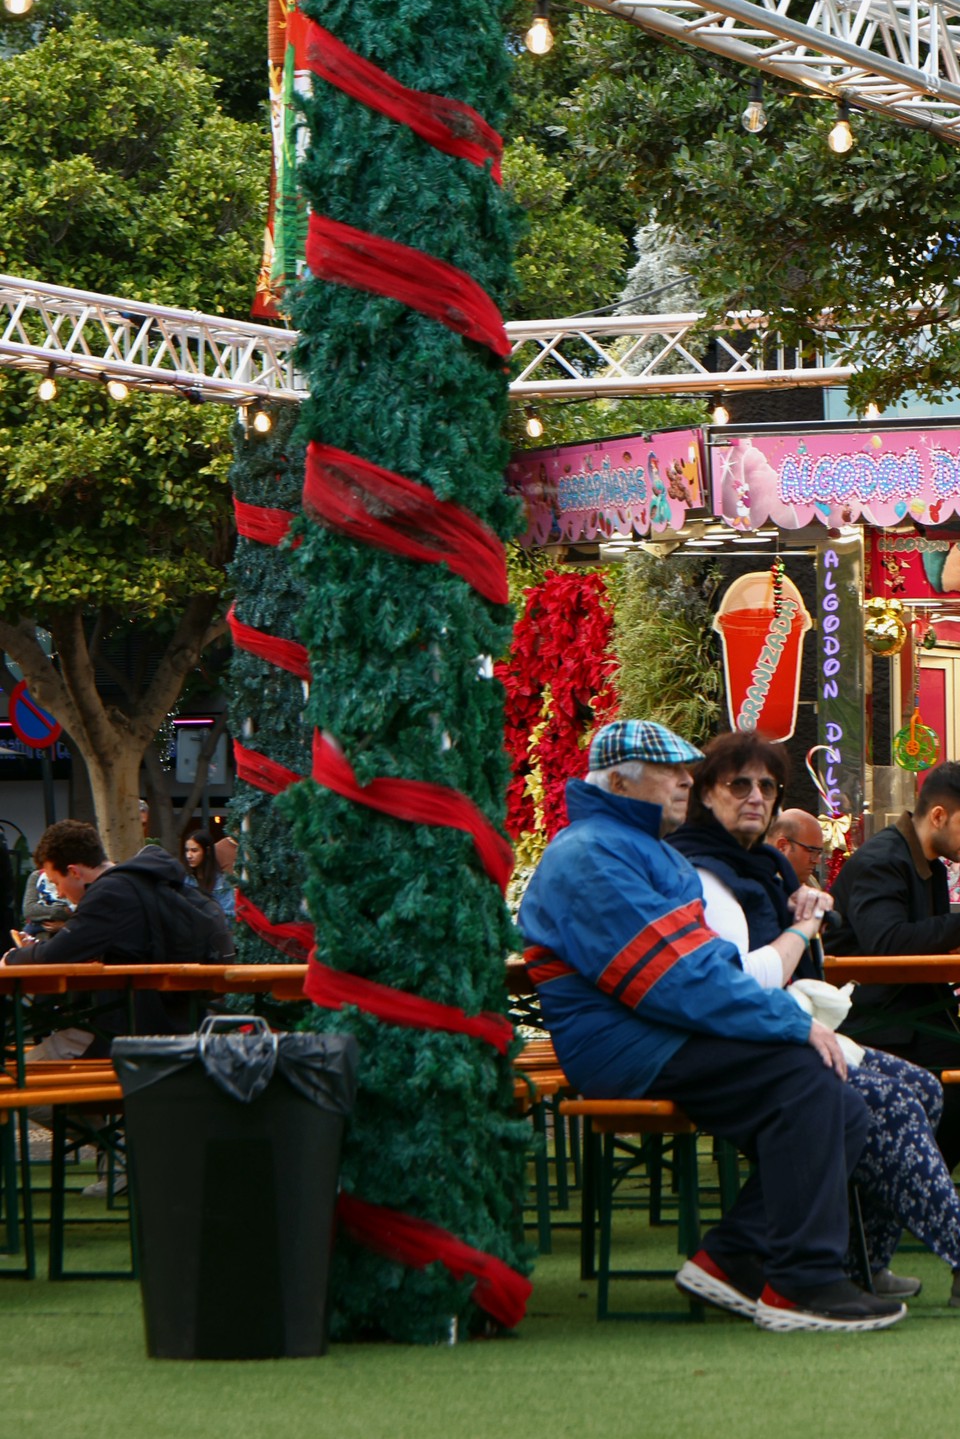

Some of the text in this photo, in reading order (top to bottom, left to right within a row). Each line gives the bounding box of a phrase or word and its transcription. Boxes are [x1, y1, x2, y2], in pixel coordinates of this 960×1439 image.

[778, 446, 923, 504] ALGODON
[737, 597, 801, 733] GRANIZADA
[822, 548, 842, 700] ALGODON
